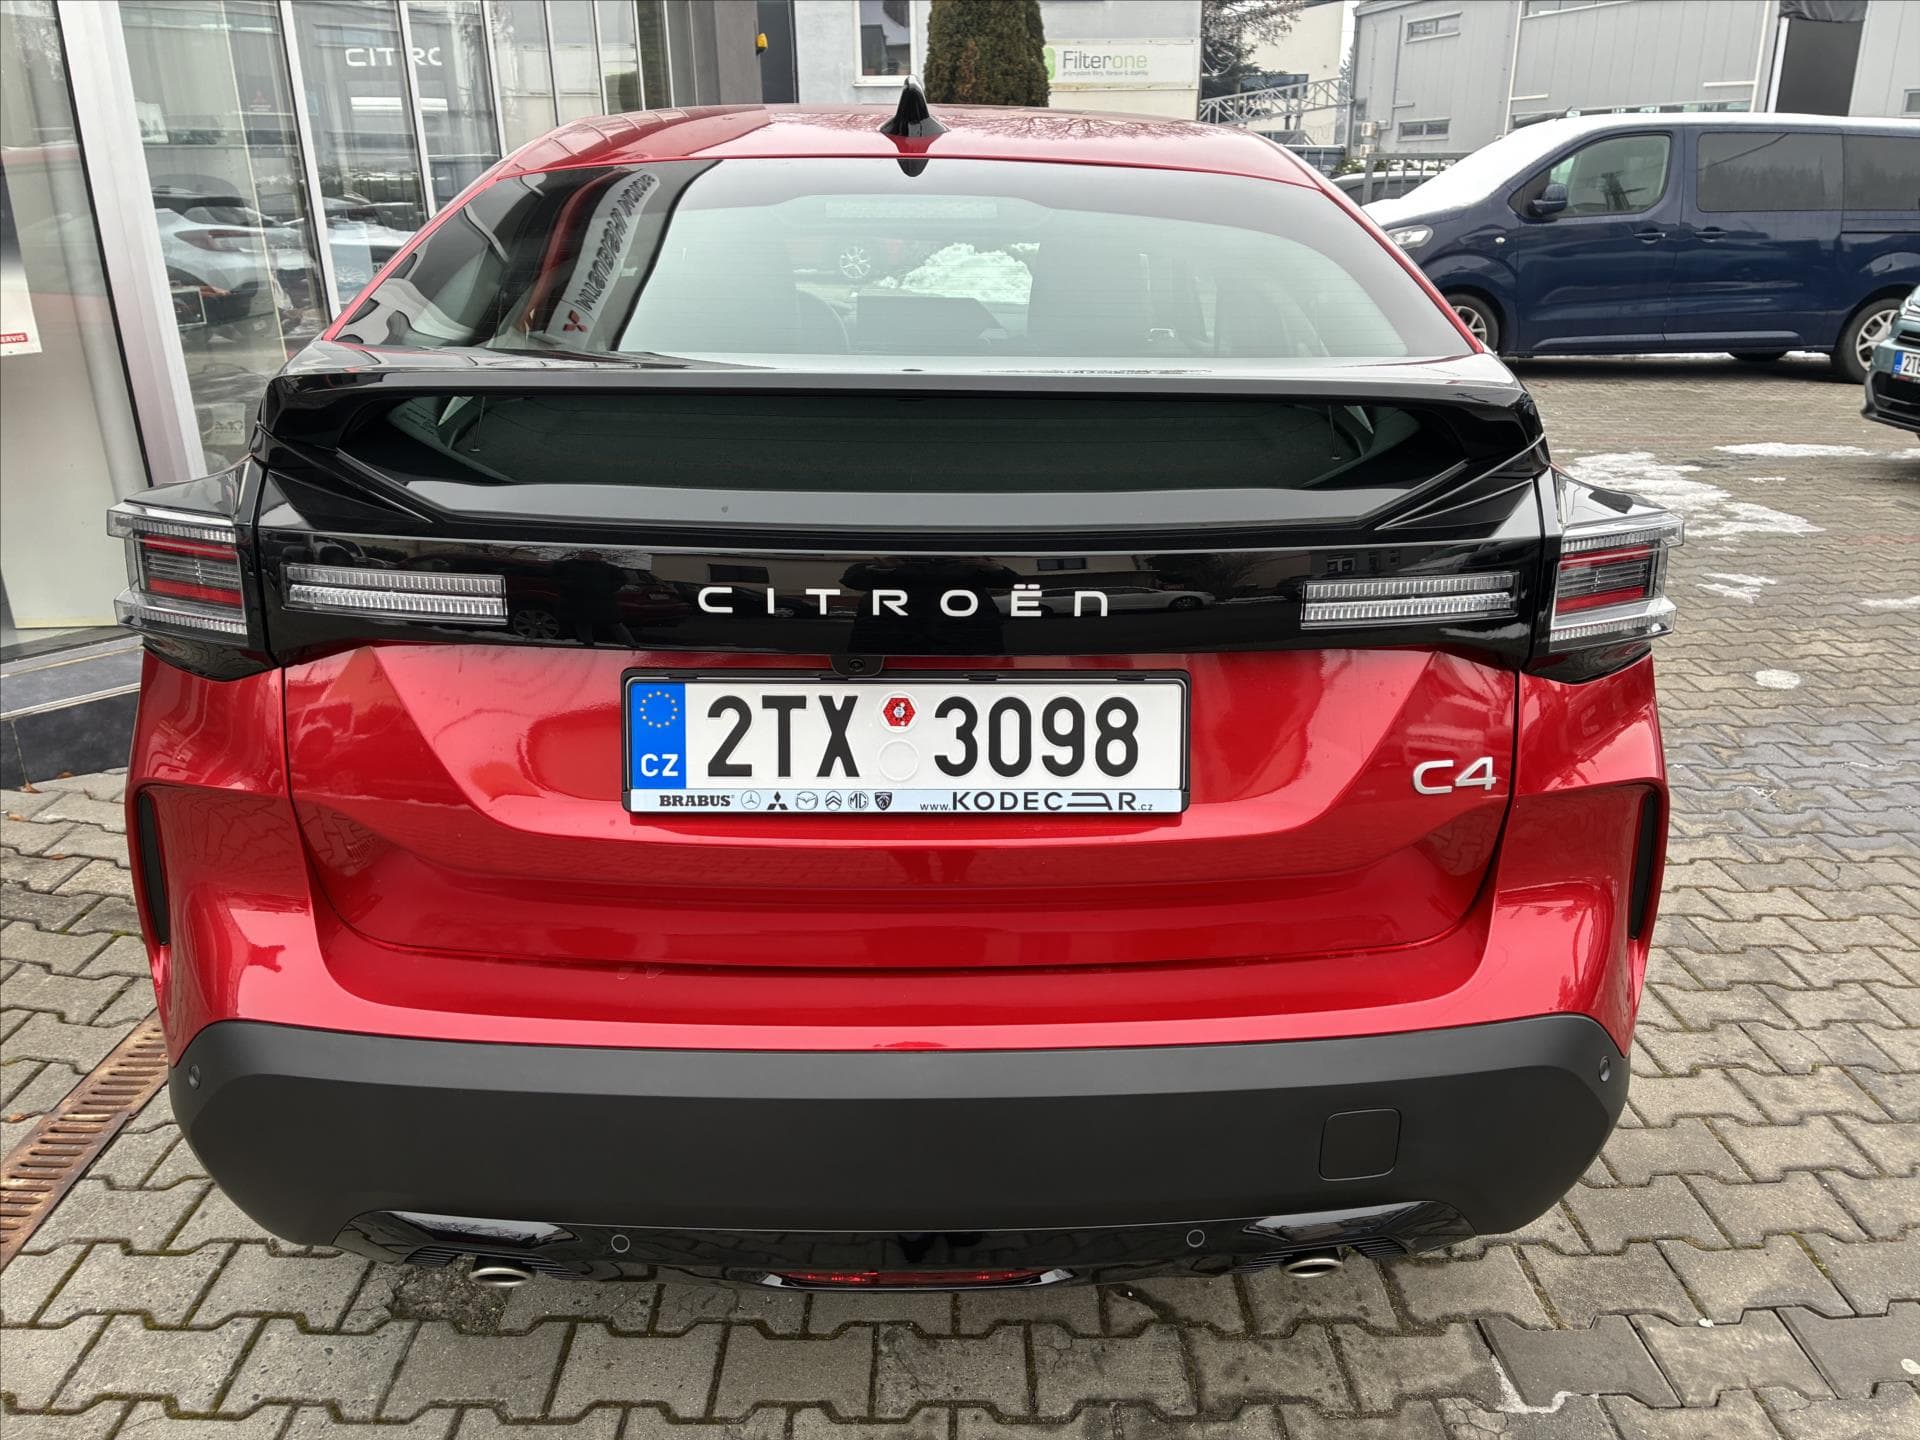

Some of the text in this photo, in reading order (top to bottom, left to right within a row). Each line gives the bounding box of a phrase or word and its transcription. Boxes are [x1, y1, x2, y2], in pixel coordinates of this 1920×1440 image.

[1062, 50, 1148, 69] Filterone
[1903, 355, 1920, 374] 2T
[698, 584, 1108, 617] CITROËN
[708, 695, 1139, 777] 2TX 3098
[640, 754, 679, 777] CZ
[1413, 756, 1497, 795] C4
[849, 792, 867, 809] MG
